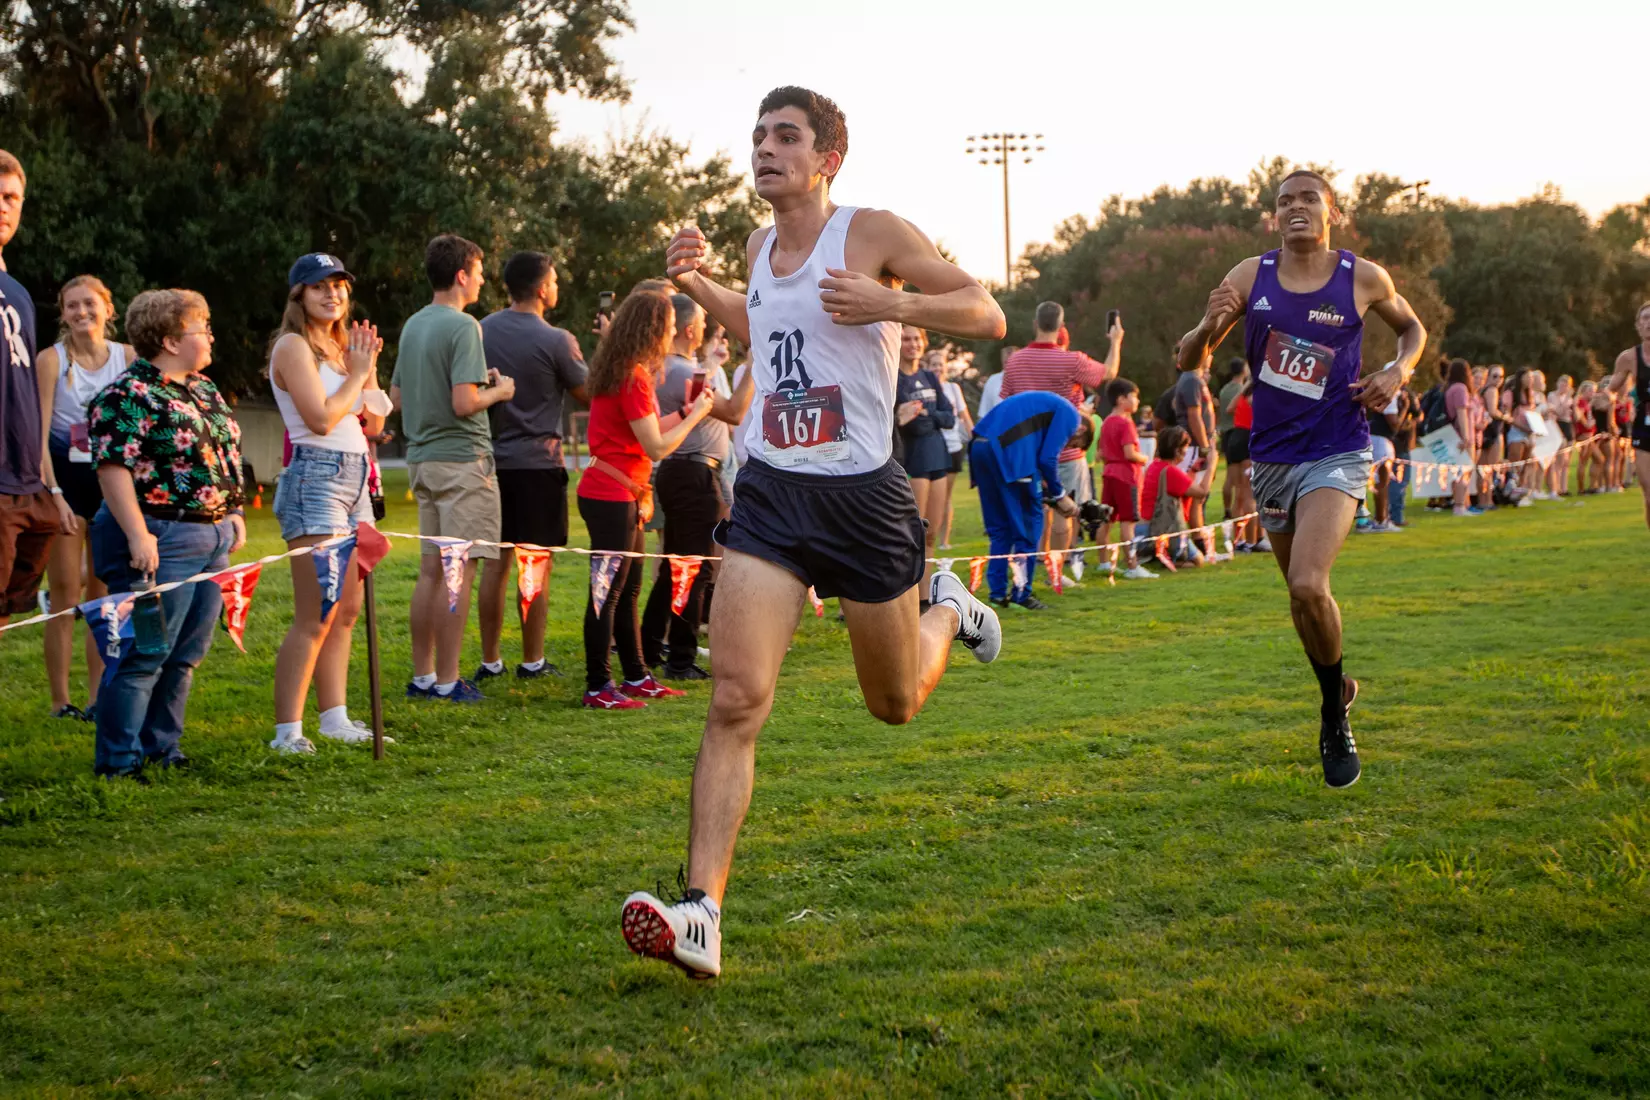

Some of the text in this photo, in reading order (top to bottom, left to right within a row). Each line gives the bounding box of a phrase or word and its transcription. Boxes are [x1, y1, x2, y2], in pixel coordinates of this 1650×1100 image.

[768, 328, 814, 393] R
[1278, 349, 1317, 380] 163
[777, 408, 822, 444] 167
